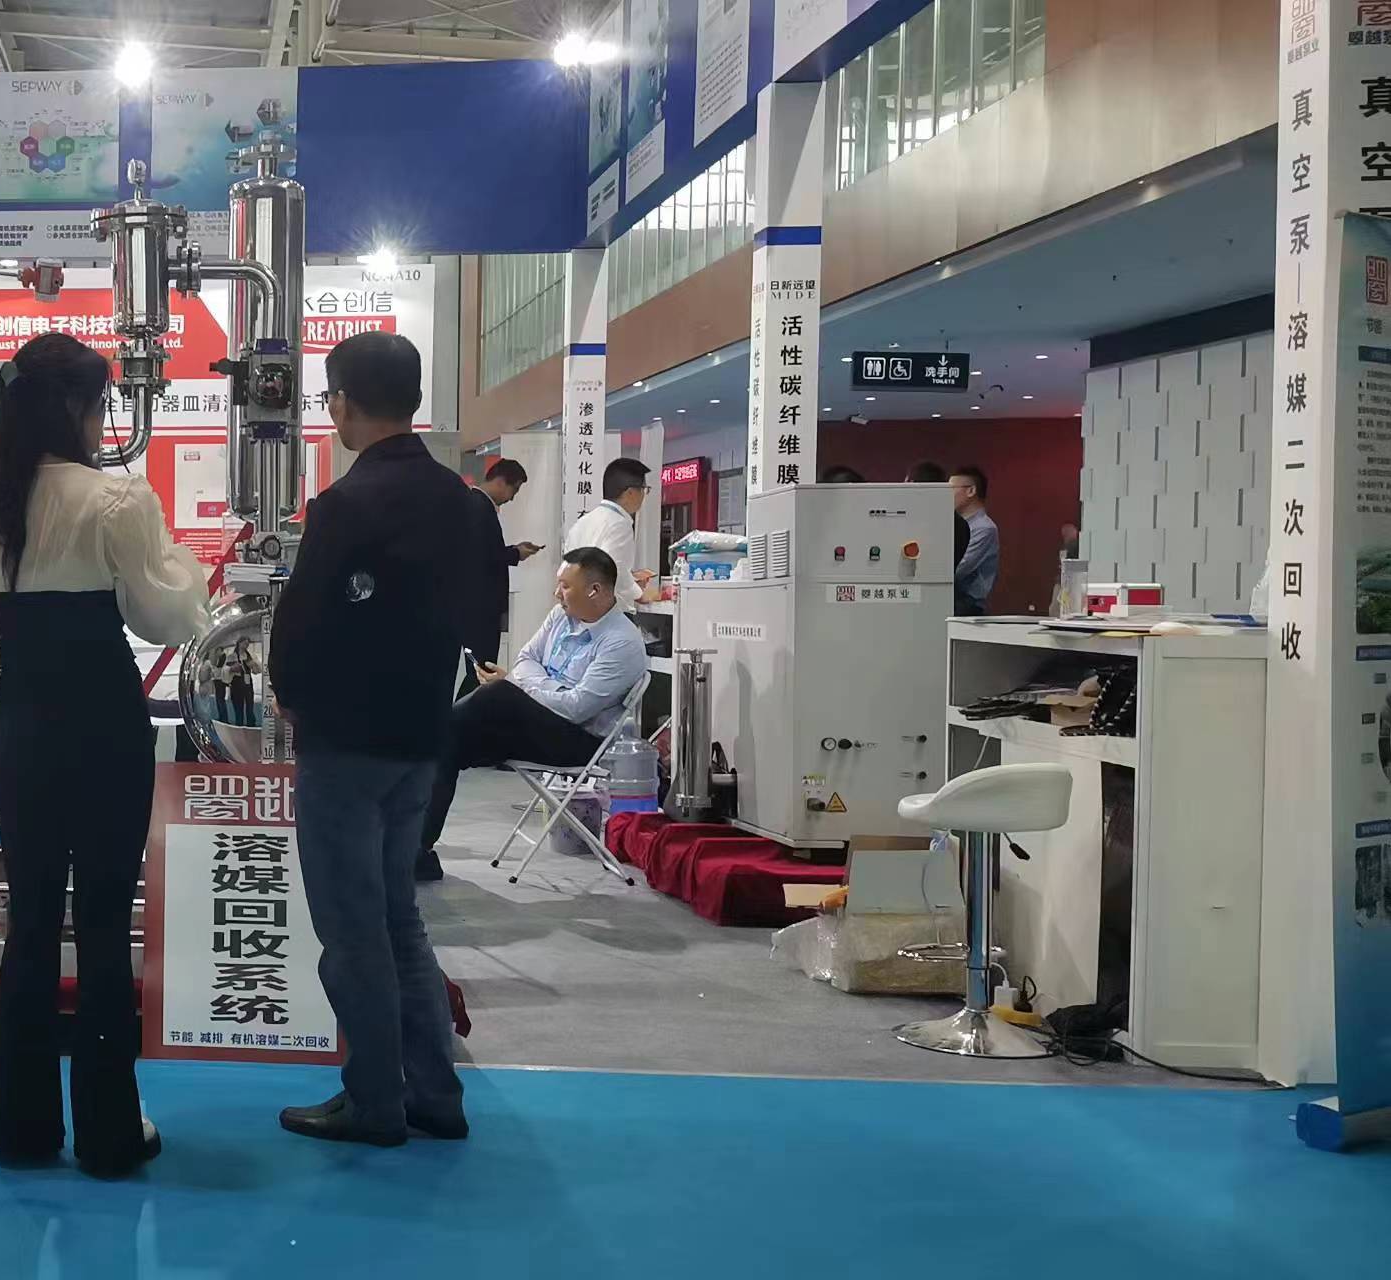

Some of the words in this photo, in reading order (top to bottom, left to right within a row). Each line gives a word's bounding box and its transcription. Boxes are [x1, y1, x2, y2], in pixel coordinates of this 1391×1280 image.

[770, 280, 816, 290] 日新远望
[305, 291, 393, 313] 合创信
[771, 291, 816, 300] MIDE
[925, 366, 960, 378] 洗手间
[776, 315, 804, 485] 活性碳纤维膜
[209, 832, 290, 1025] 溶媒回收系统
[170, 1030, 193, 1043] 节能
[200, 1031, 223, 1044] 减排
[230, 1032, 330, 1049] 有机溶媒二次回收
